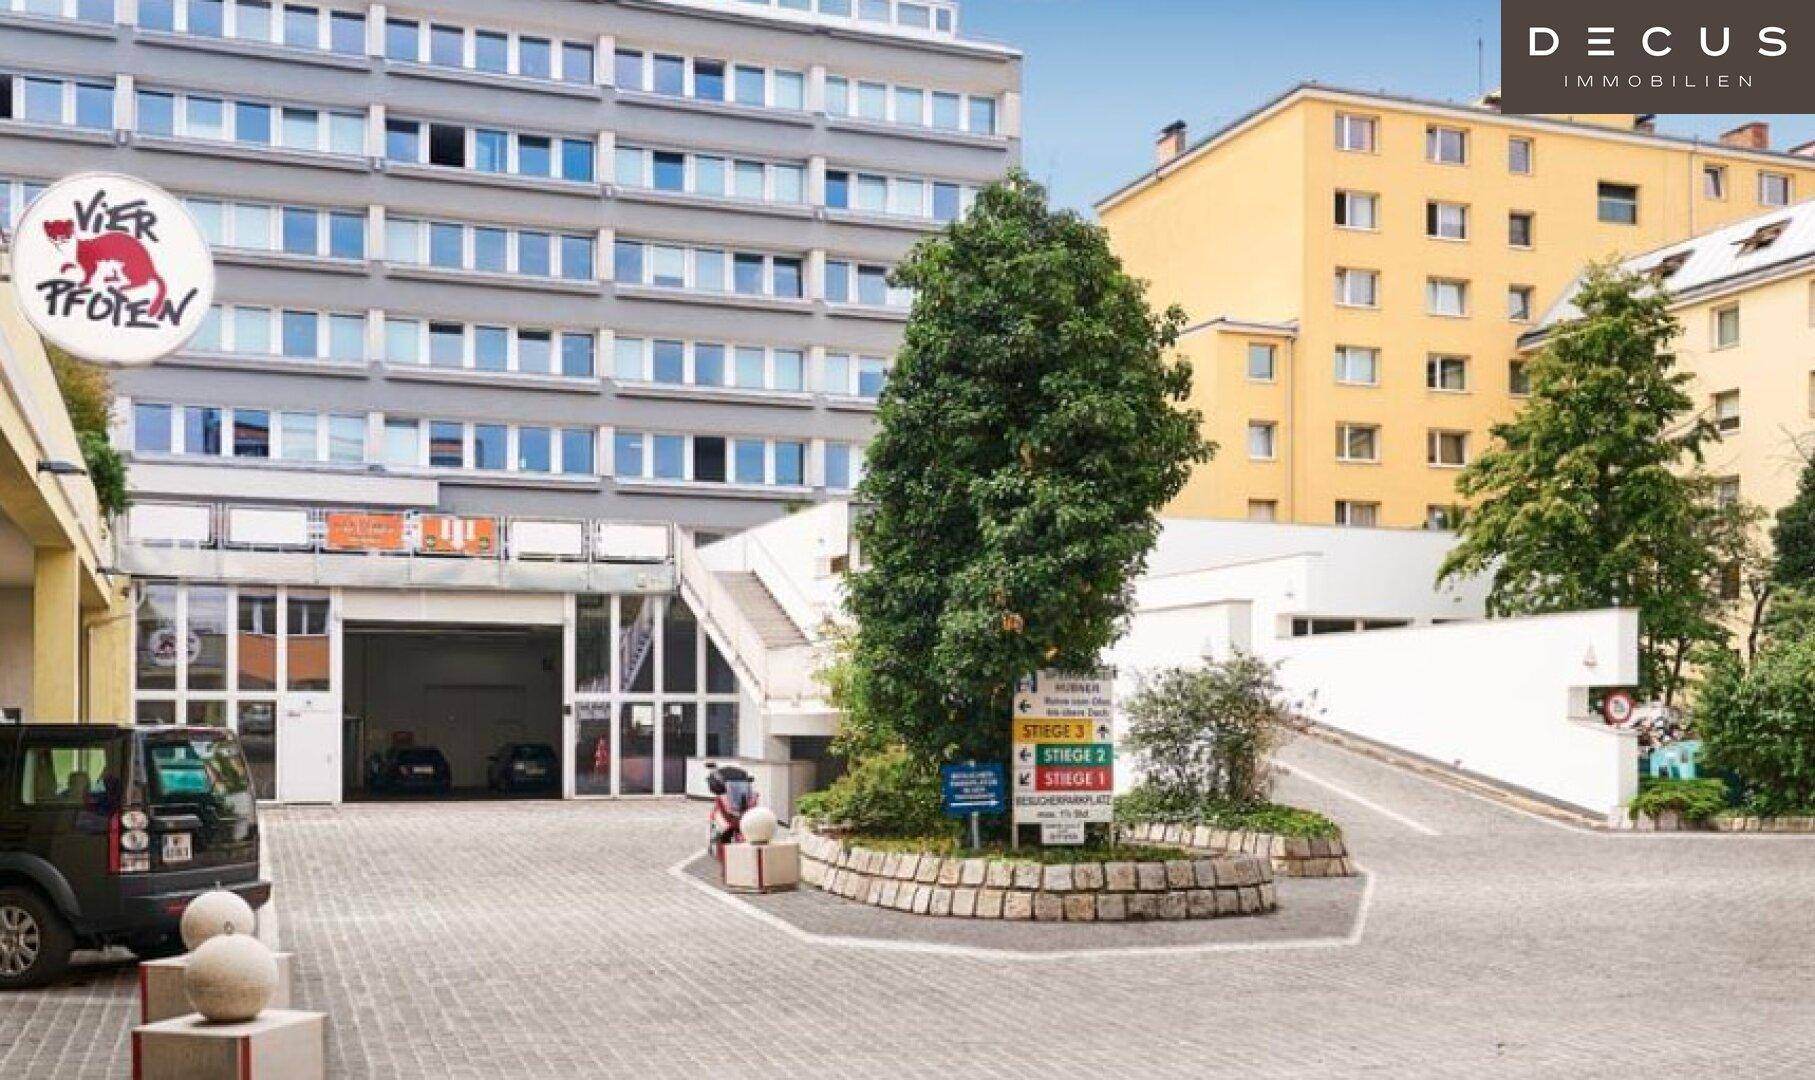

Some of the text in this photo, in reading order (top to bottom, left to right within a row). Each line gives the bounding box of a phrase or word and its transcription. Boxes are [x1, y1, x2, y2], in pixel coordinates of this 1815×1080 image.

[36, 278, 198, 329] PFOTEN
[1022, 724, 1085, 739] STIEGE 3
[1043, 747, 1106, 762] STIEGE 2
[1044, 771, 1106, 785] STIEGE 1
